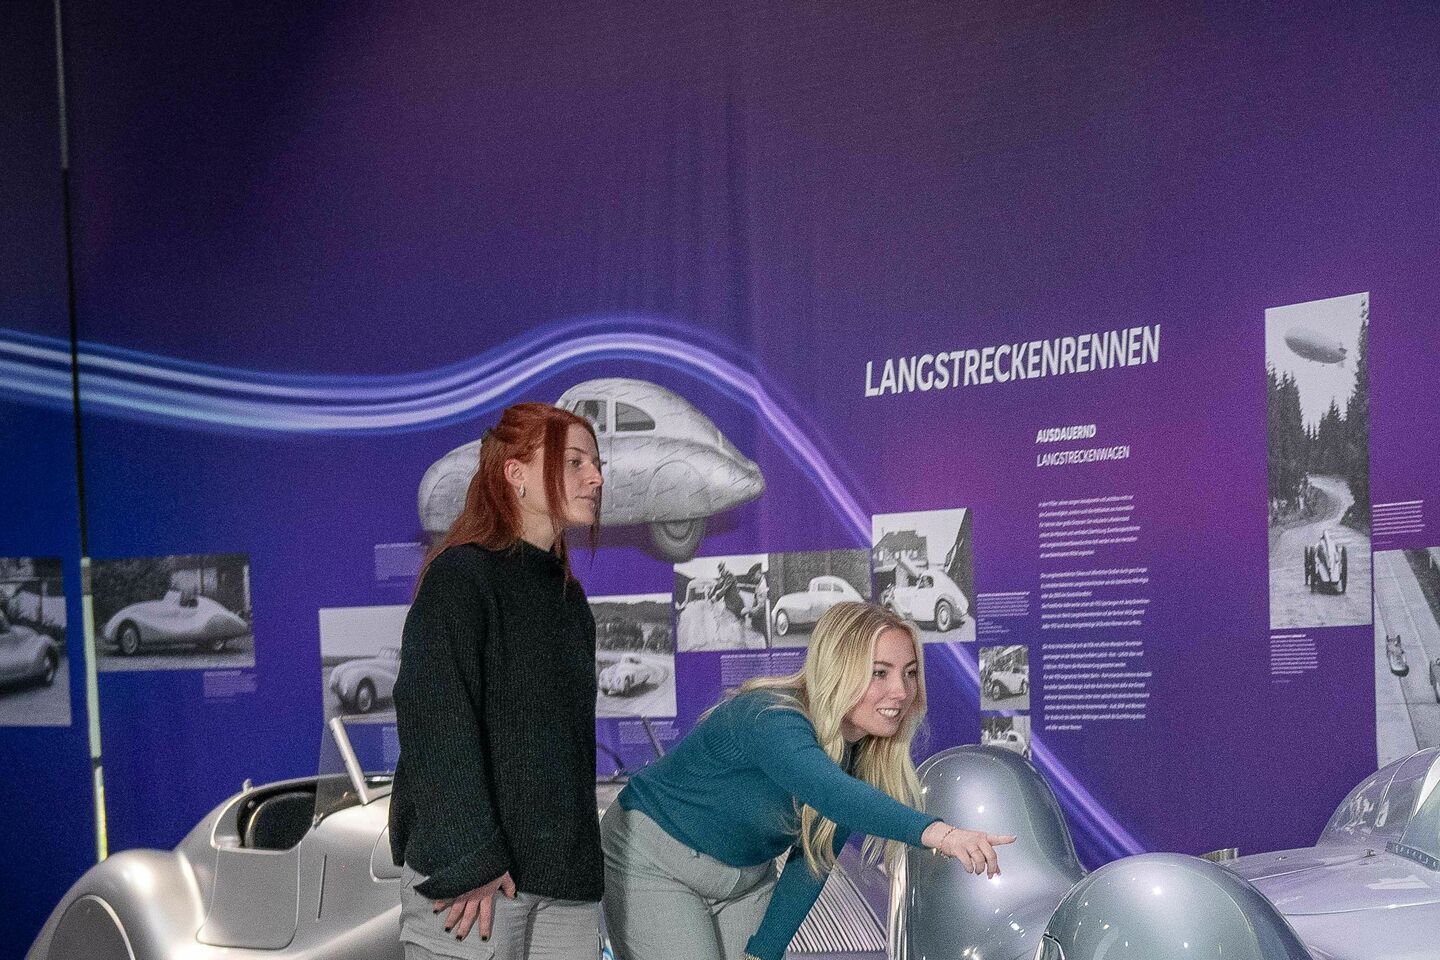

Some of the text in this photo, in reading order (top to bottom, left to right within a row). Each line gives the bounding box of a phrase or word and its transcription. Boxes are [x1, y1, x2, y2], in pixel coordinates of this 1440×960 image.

[864, 324, 1161, 398] LANGSTRECKENRENNEN
[1036, 424, 1097, 443] AUSDAUERND
[1036, 445, 1130, 467] LANGSTRECKENWAGEN
